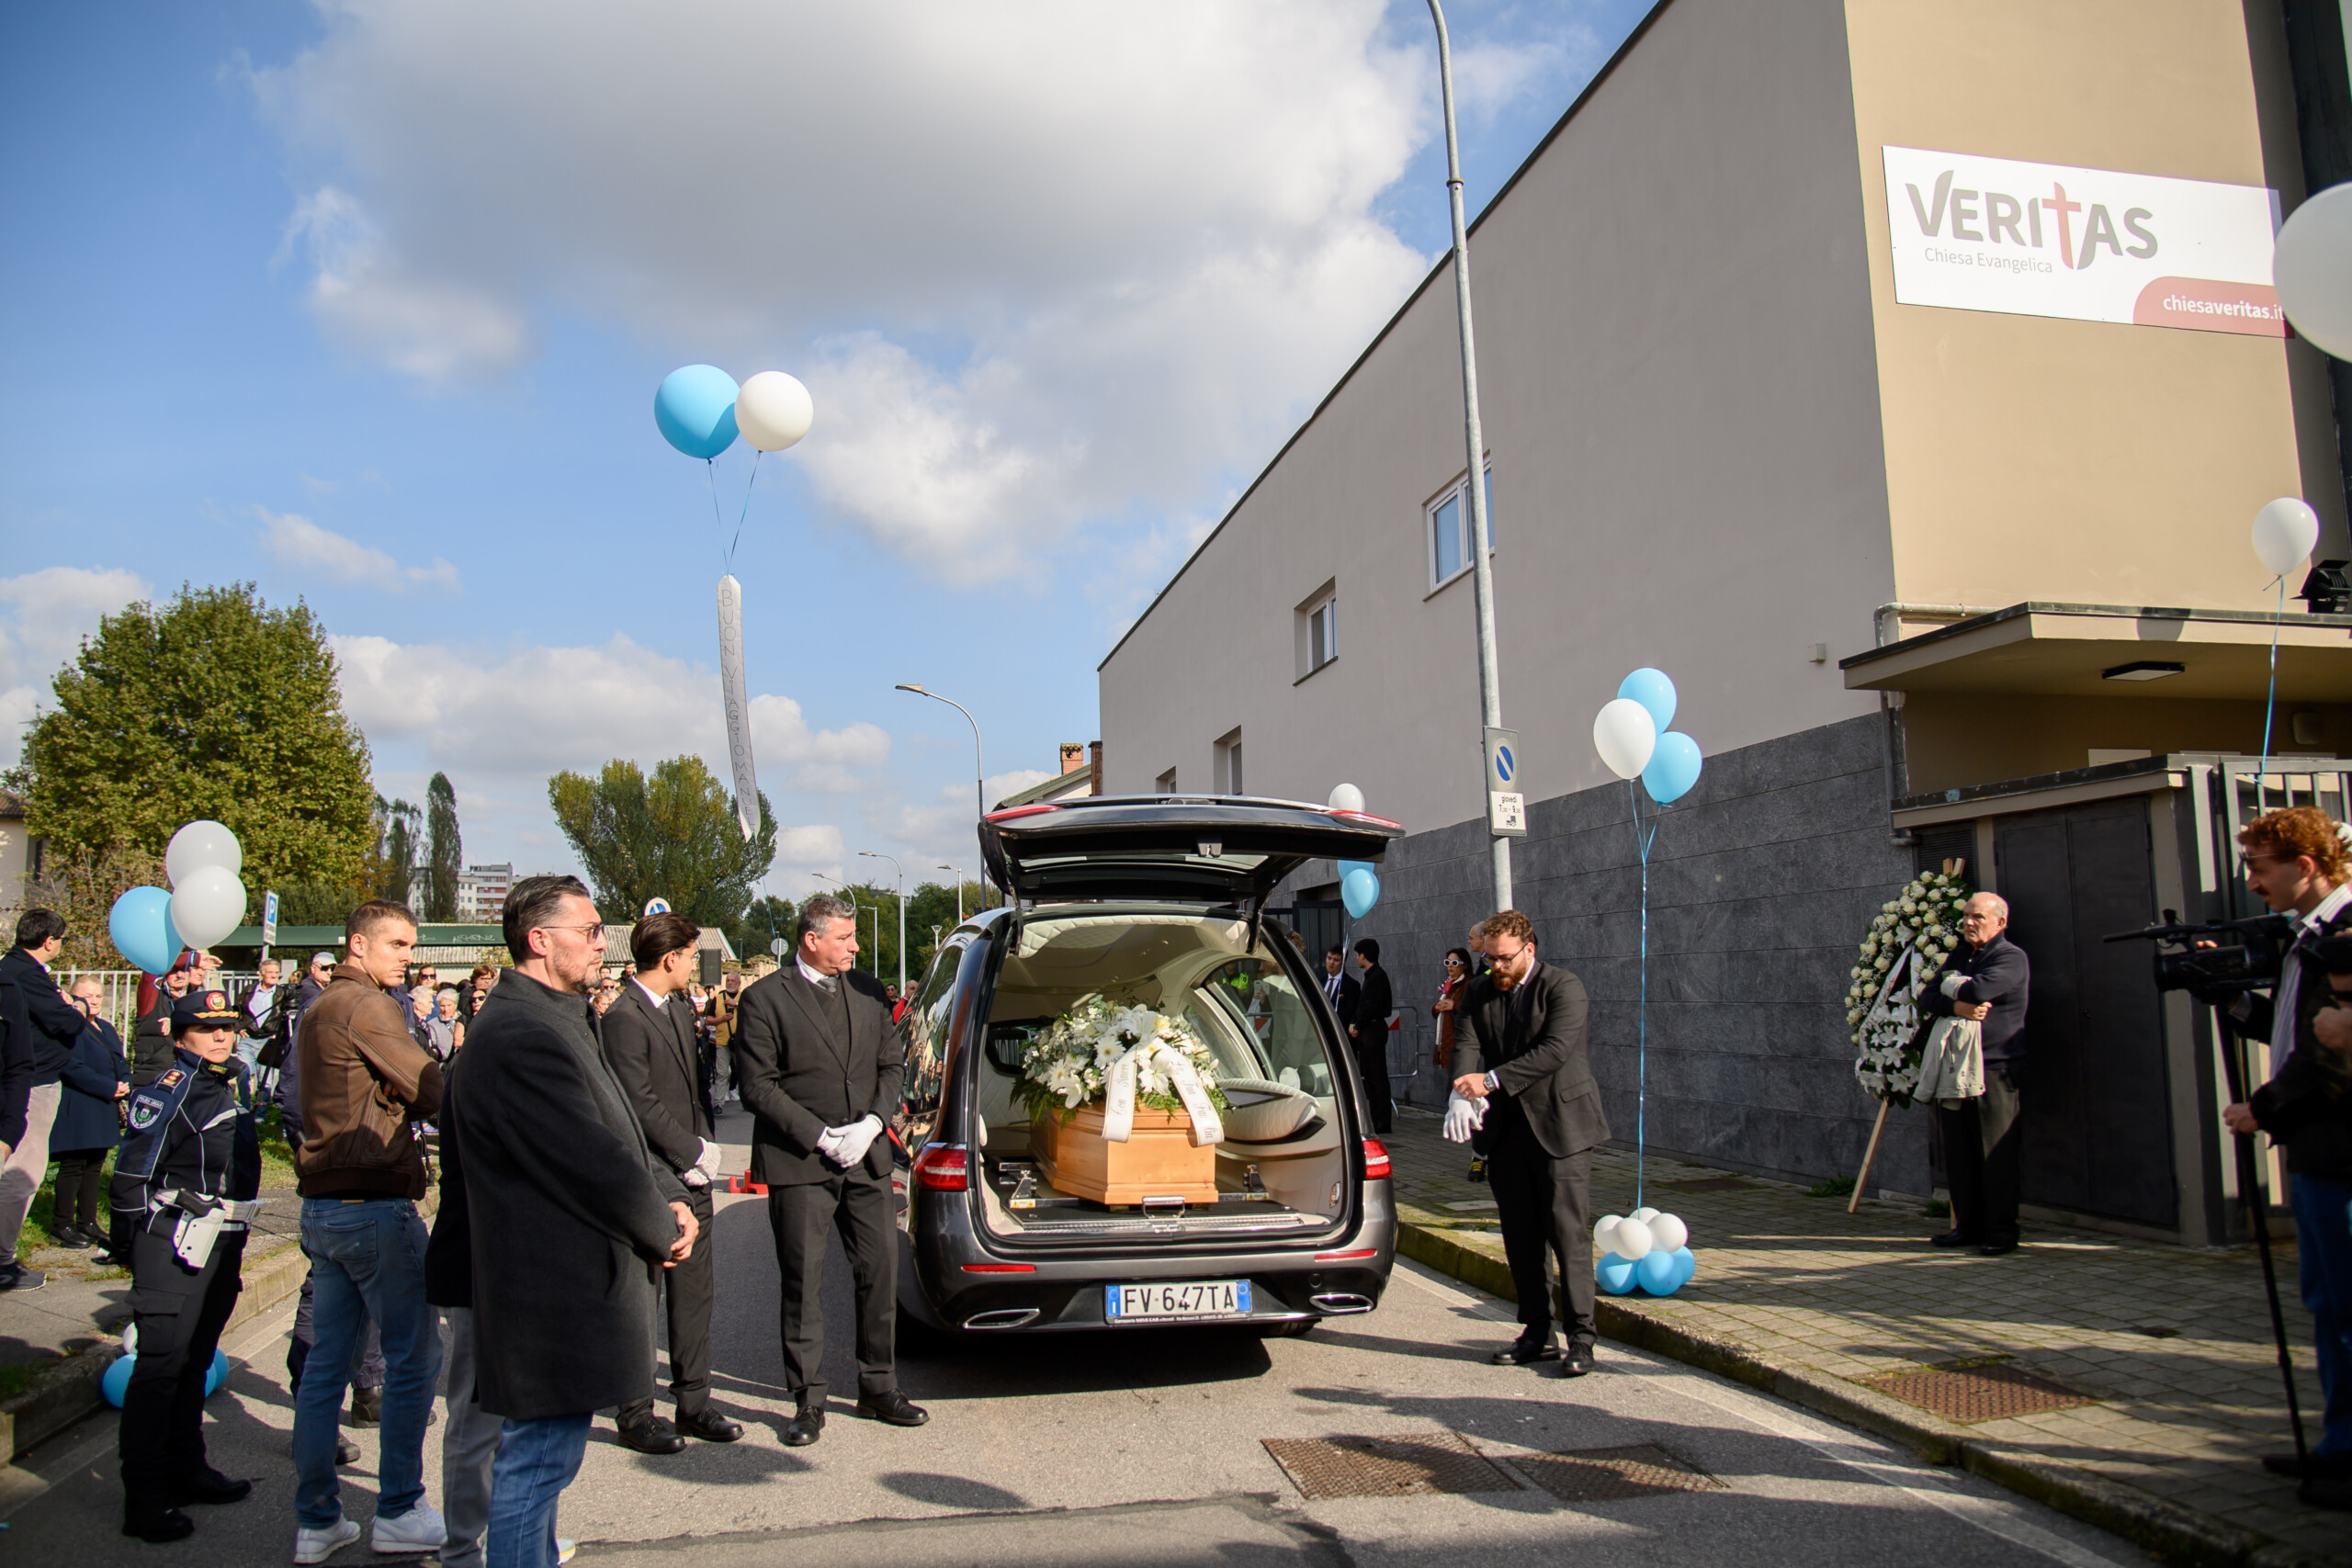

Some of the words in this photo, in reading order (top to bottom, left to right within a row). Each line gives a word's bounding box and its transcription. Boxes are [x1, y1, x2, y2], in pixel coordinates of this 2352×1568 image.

[1905, 170, 2158, 270] VERITAS
[1925, 247, 1973, 265] Chiesa
[1977, 252, 2052, 274] Evangelica
[2163, 294, 2285, 321] chiesaveritas.it
[721, 589, 737, 656] BUON
[735, 761, 756, 826] MANUEL
[269, 899, 276, 919] P
[1125, 1289, 1151, 1313] FV
[1162, 1285, 1235, 1312] 647TA
